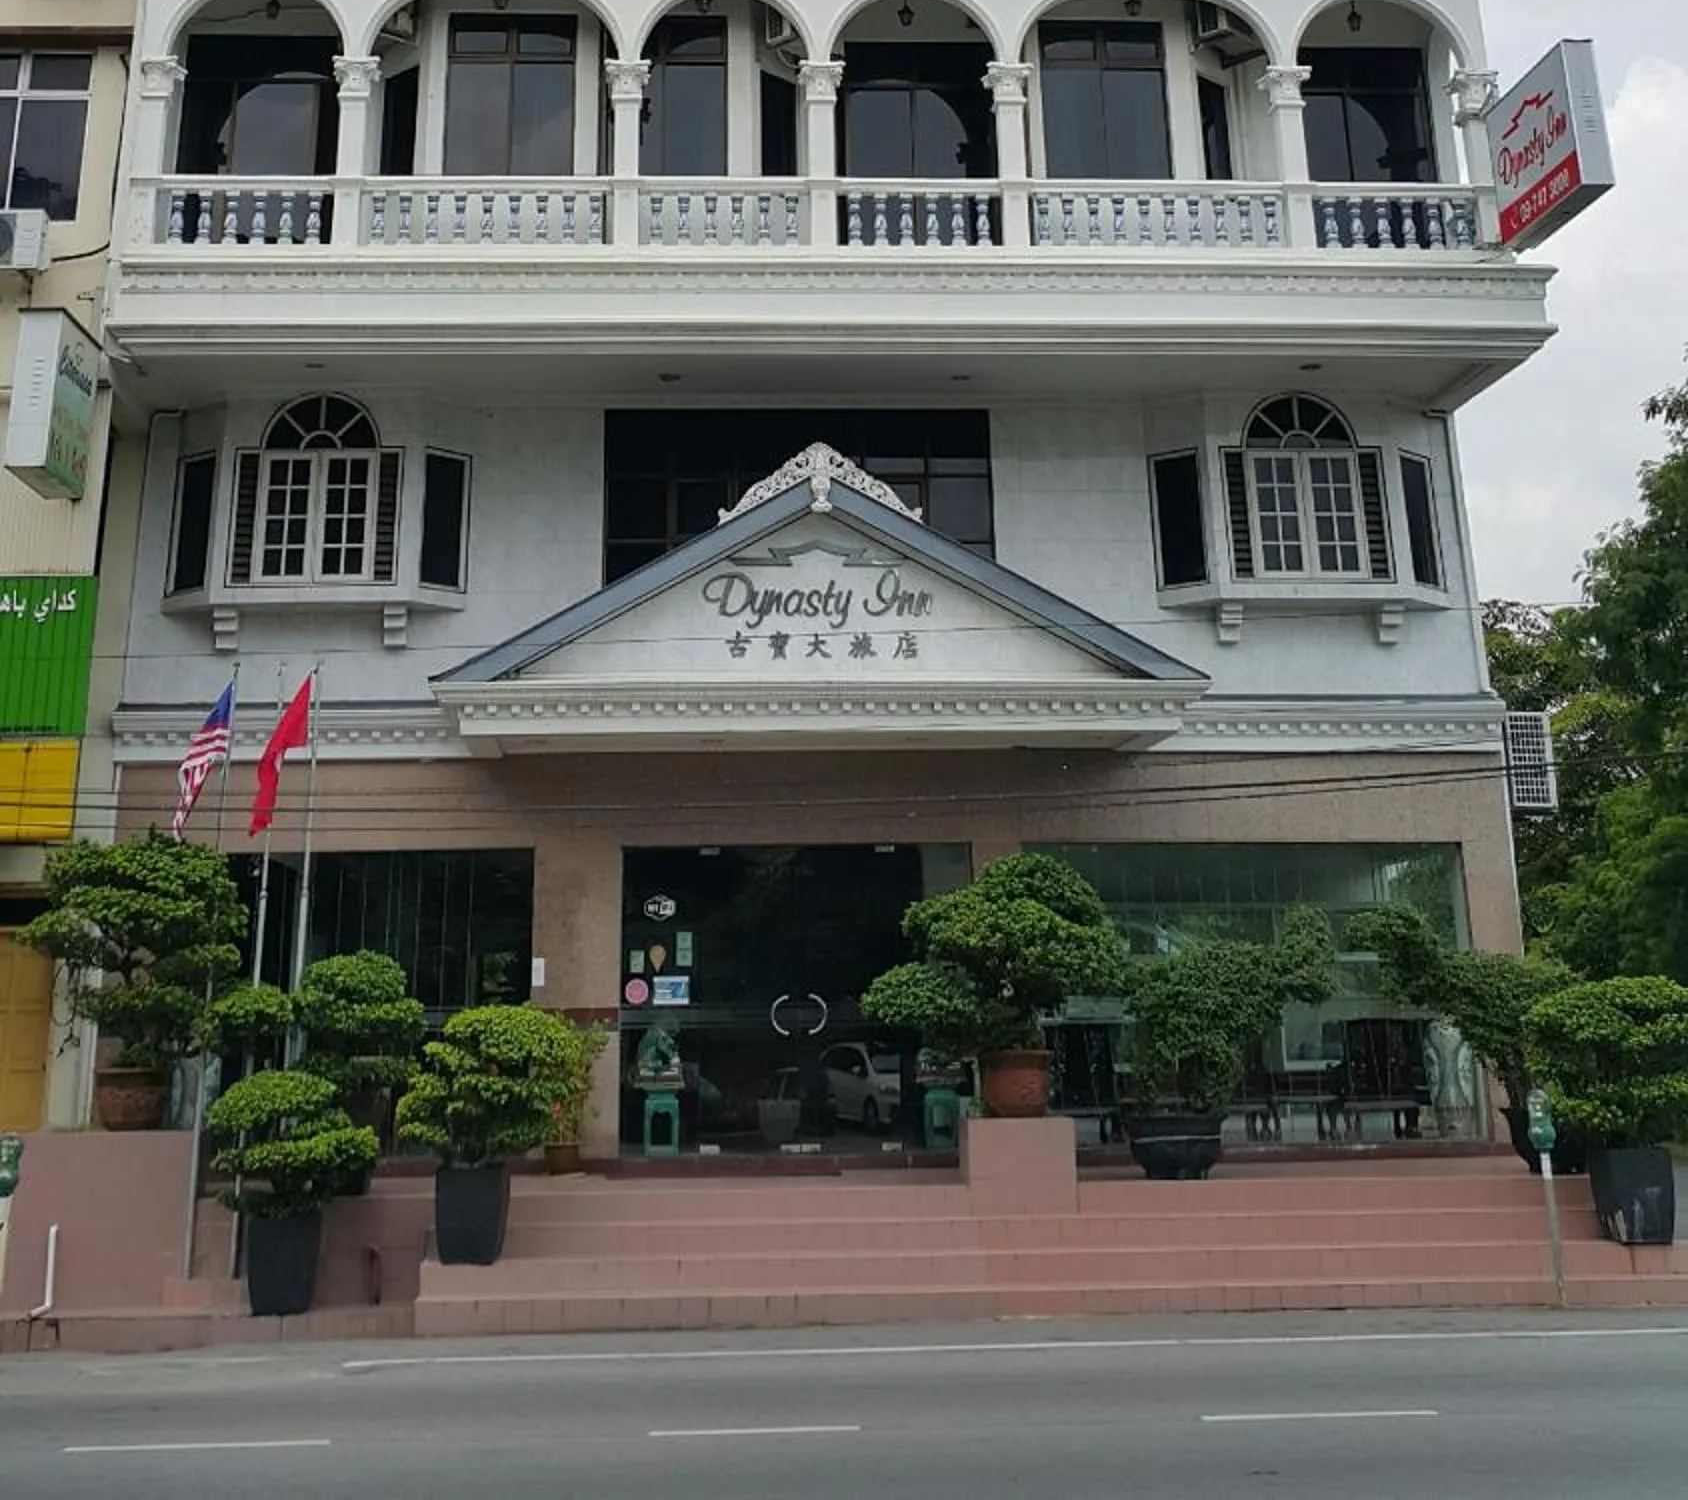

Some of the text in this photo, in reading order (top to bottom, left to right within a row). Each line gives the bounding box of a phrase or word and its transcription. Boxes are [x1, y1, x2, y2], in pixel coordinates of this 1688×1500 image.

[1497, 104, 1568, 189] Dynasty Inn
[702, 568, 933, 629] Dynasty Inn
